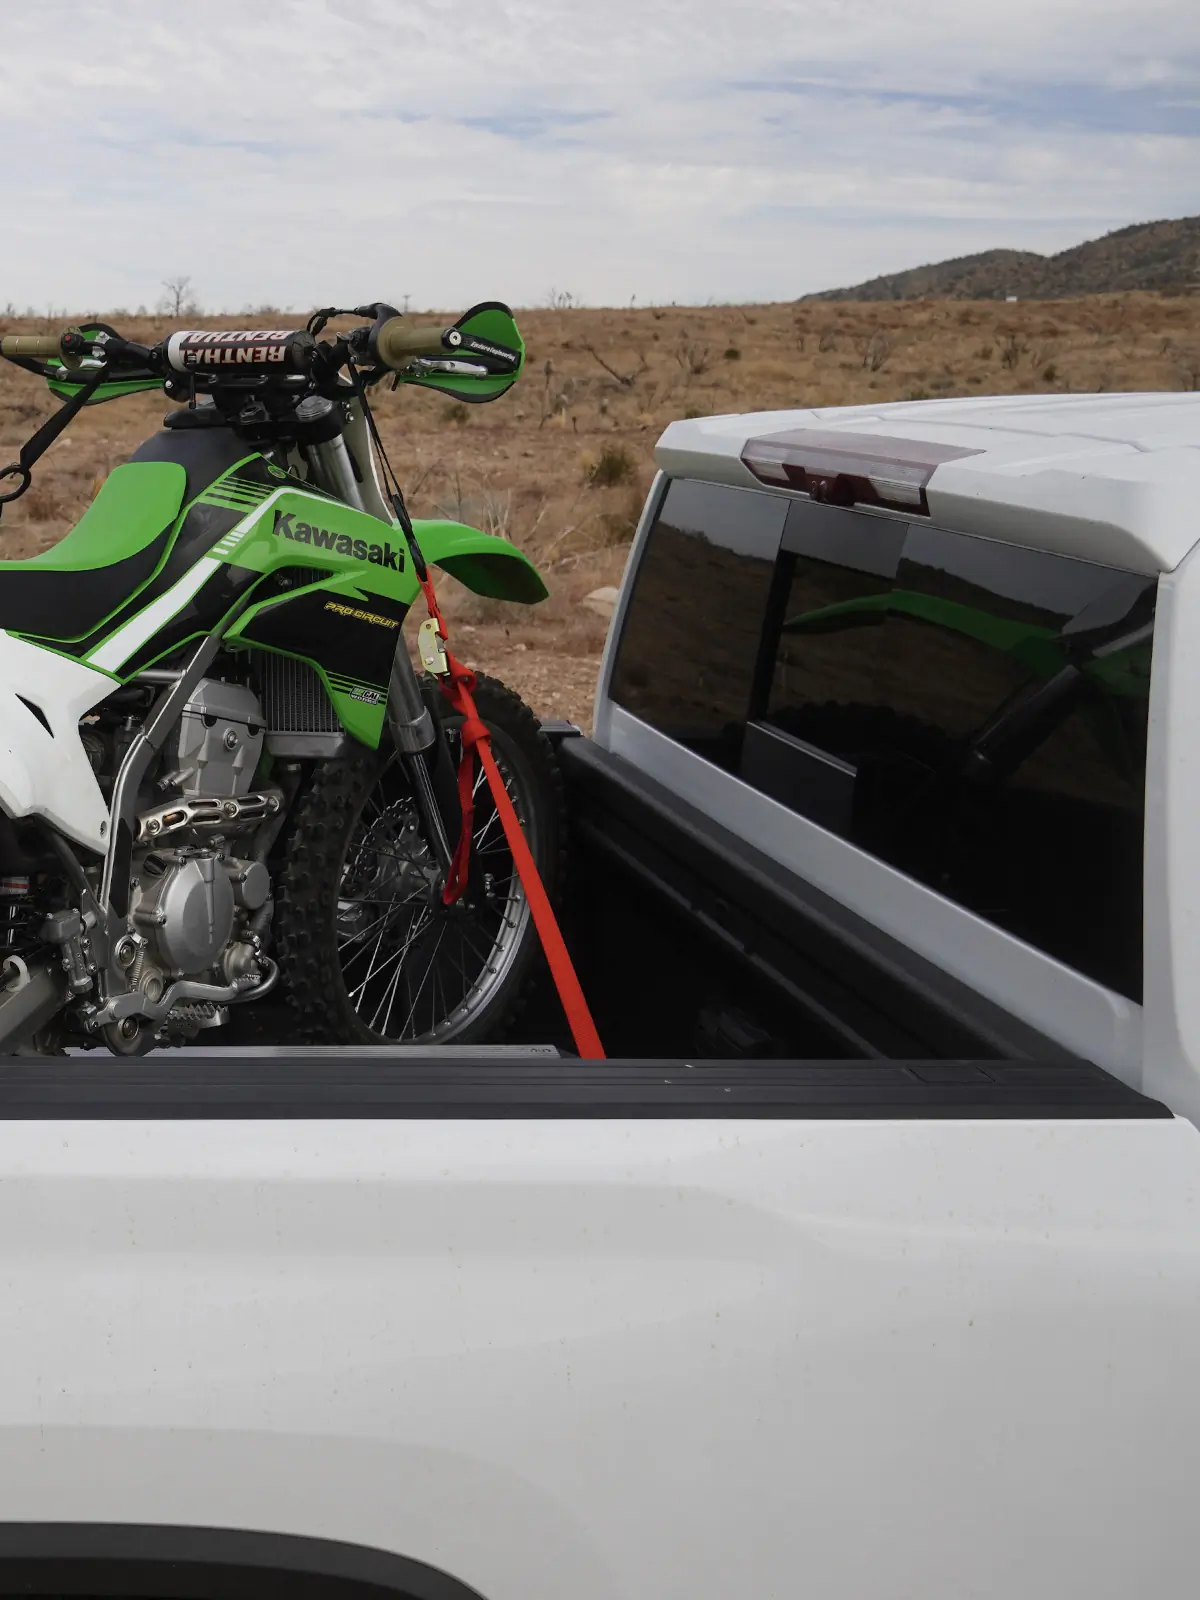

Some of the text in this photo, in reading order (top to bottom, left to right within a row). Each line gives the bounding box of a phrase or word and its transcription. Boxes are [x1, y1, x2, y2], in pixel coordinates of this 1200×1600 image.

[272, 509, 405, 573] Kawasaki
[324, 601, 400, 630] PRO CIRCUIT
